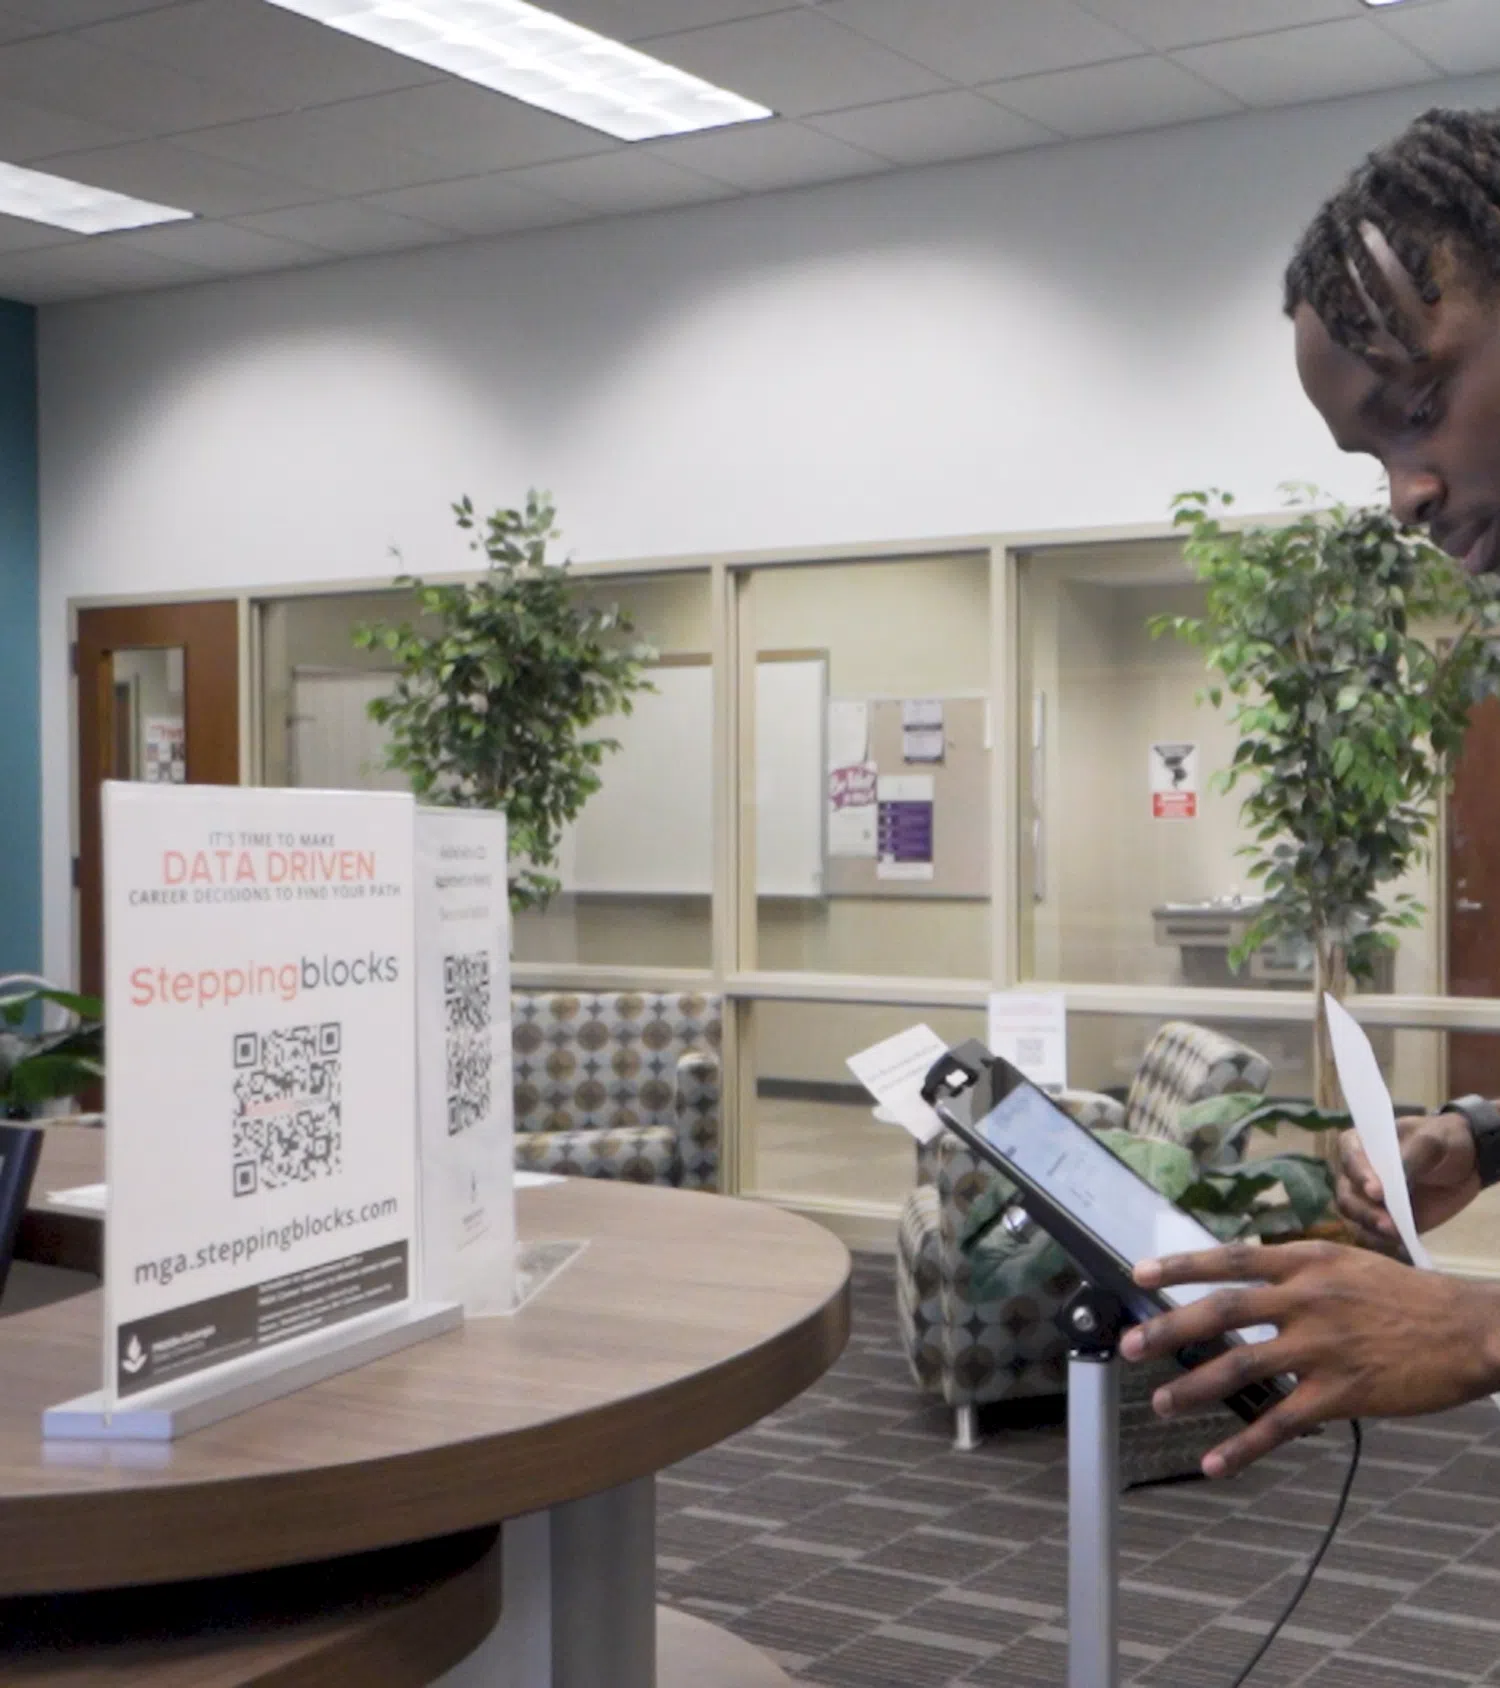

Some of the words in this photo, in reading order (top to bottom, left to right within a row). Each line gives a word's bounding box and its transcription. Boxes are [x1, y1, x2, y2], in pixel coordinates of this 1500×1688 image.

[209, 832, 234, 847] IT'S
[240, 833, 271, 847] TIME
[278, 833, 295, 847] TO
[300, 833, 335, 847] MAKE
[162, 850, 256, 885] DATA
[267, 850, 377, 884] DRIVEN
[129, 888, 187, 906] CAREER
[194, 887, 270, 904] DECISIONS
[276, 886, 293, 901] TO
[299, 885, 328, 900] FIND
[332, 884, 365, 899] YOUR
[369, 882, 401, 897] PATH
[129, 950, 399, 1008] Steppingblocks
[134, 1197, 398, 1286] mga.steppingblocks.com
